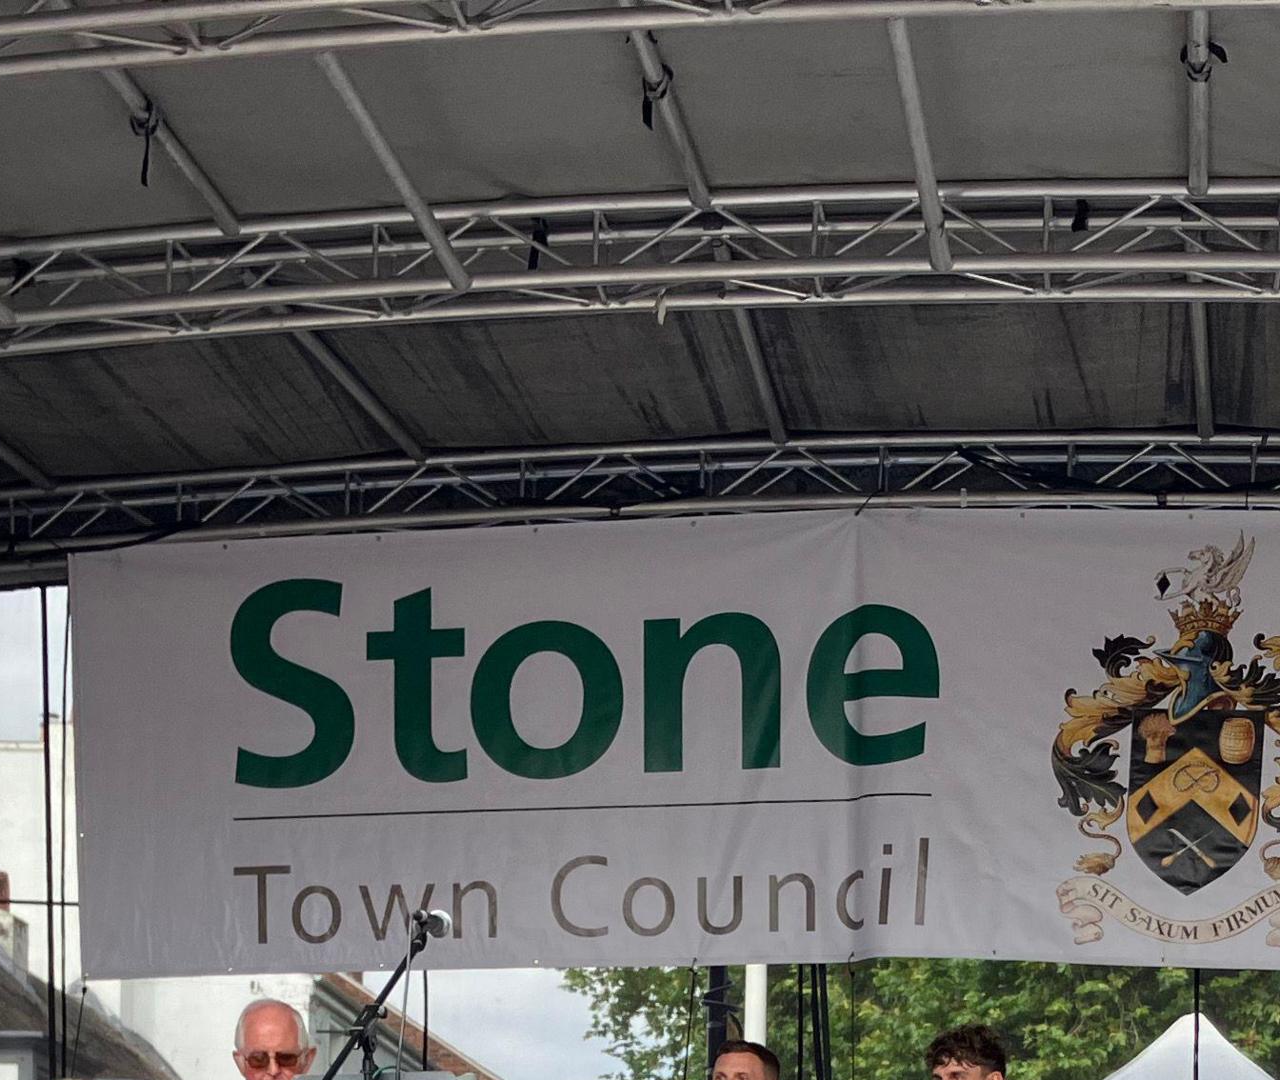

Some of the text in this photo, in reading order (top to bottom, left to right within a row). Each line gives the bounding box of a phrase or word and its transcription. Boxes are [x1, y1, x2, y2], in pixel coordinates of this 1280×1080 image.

[230, 578, 940, 789] Stone
[233, 838, 930, 945] Town Council
[1087, 883, 1122, 909] SIT
[1124, 907, 1198, 940] SAXUM
